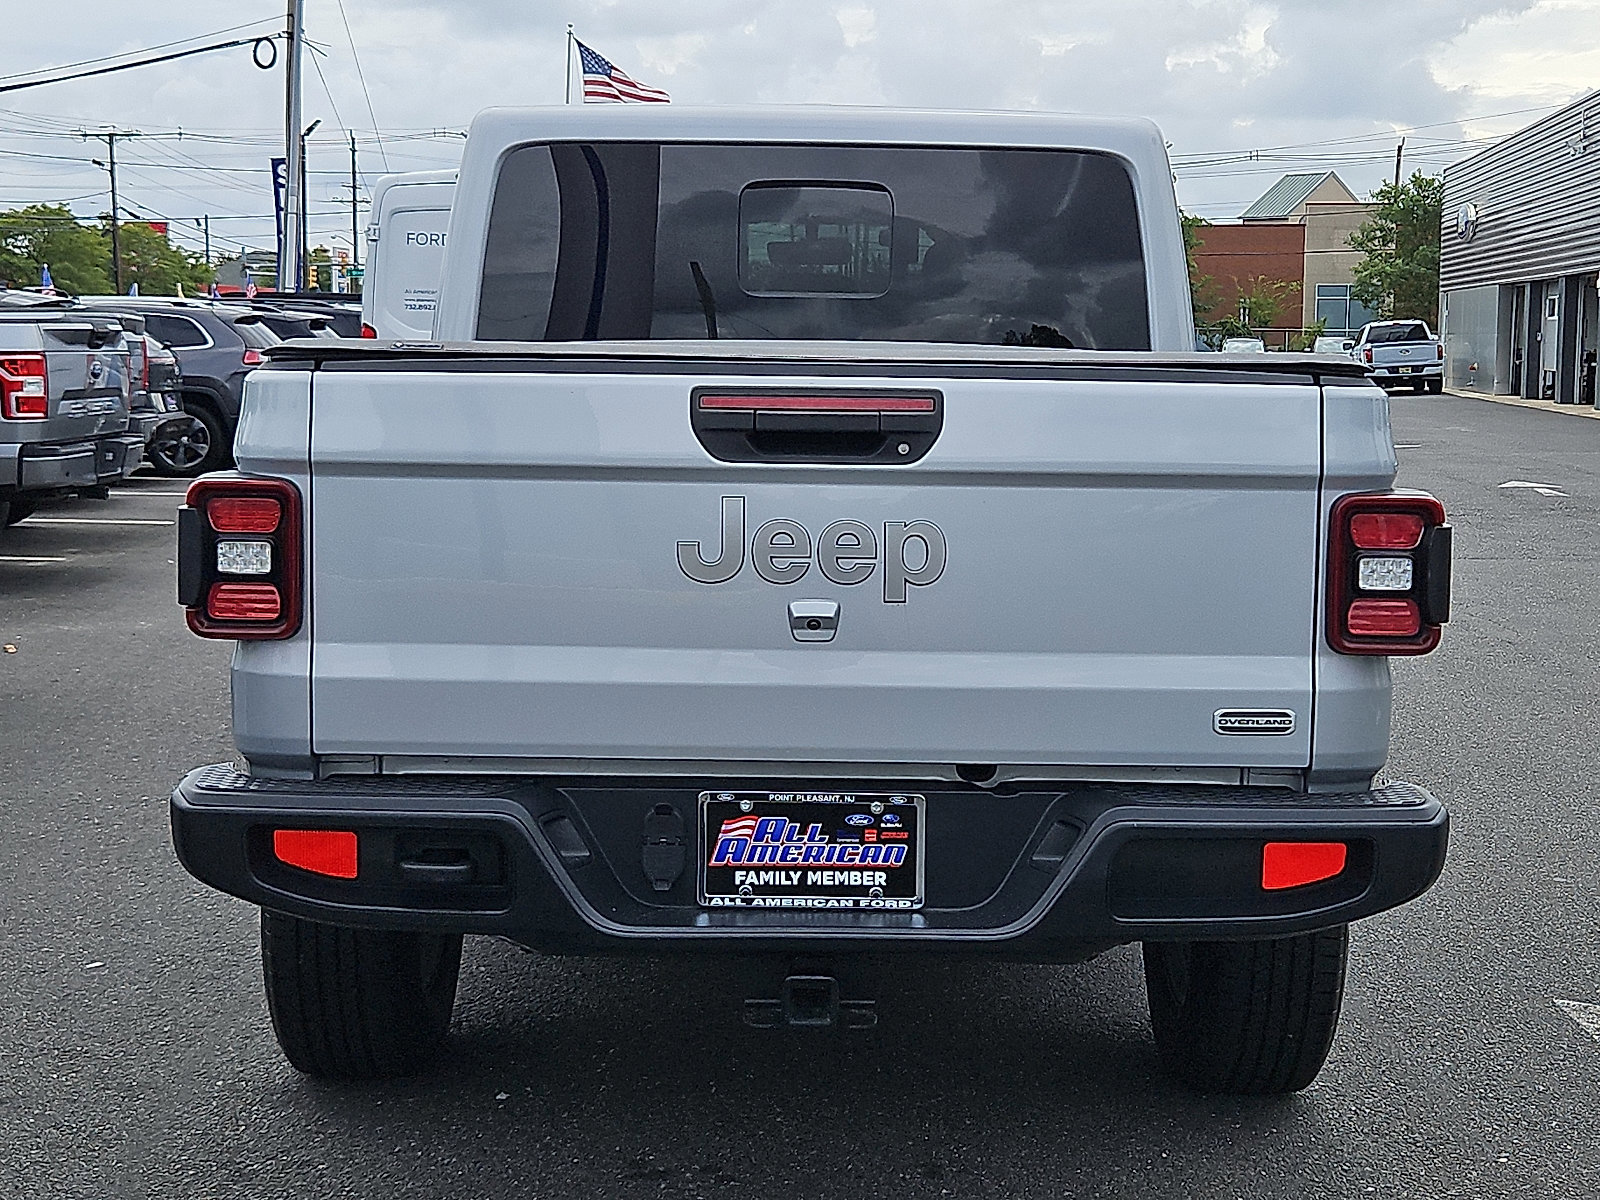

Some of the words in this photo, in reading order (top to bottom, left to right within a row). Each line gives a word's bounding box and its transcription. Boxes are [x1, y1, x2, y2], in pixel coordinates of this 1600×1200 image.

[676, 496, 947, 603] Jeep
[1218, 718, 1293, 726] OVERLAND
[768, 793, 794, 801] POINT
[796, 794, 842, 803] PLEASANT,
[844, 795, 855, 803] NJ
[711, 837, 908, 866] AMERICAN
[734, 870, 802, 886] FAMILY
[807, 871, 887, 886] MEMBER
[710, 897, 747, 906] ALL
[752, 898, 854, 907] AMERICAN
[860, 899, 912, 908] FORD
